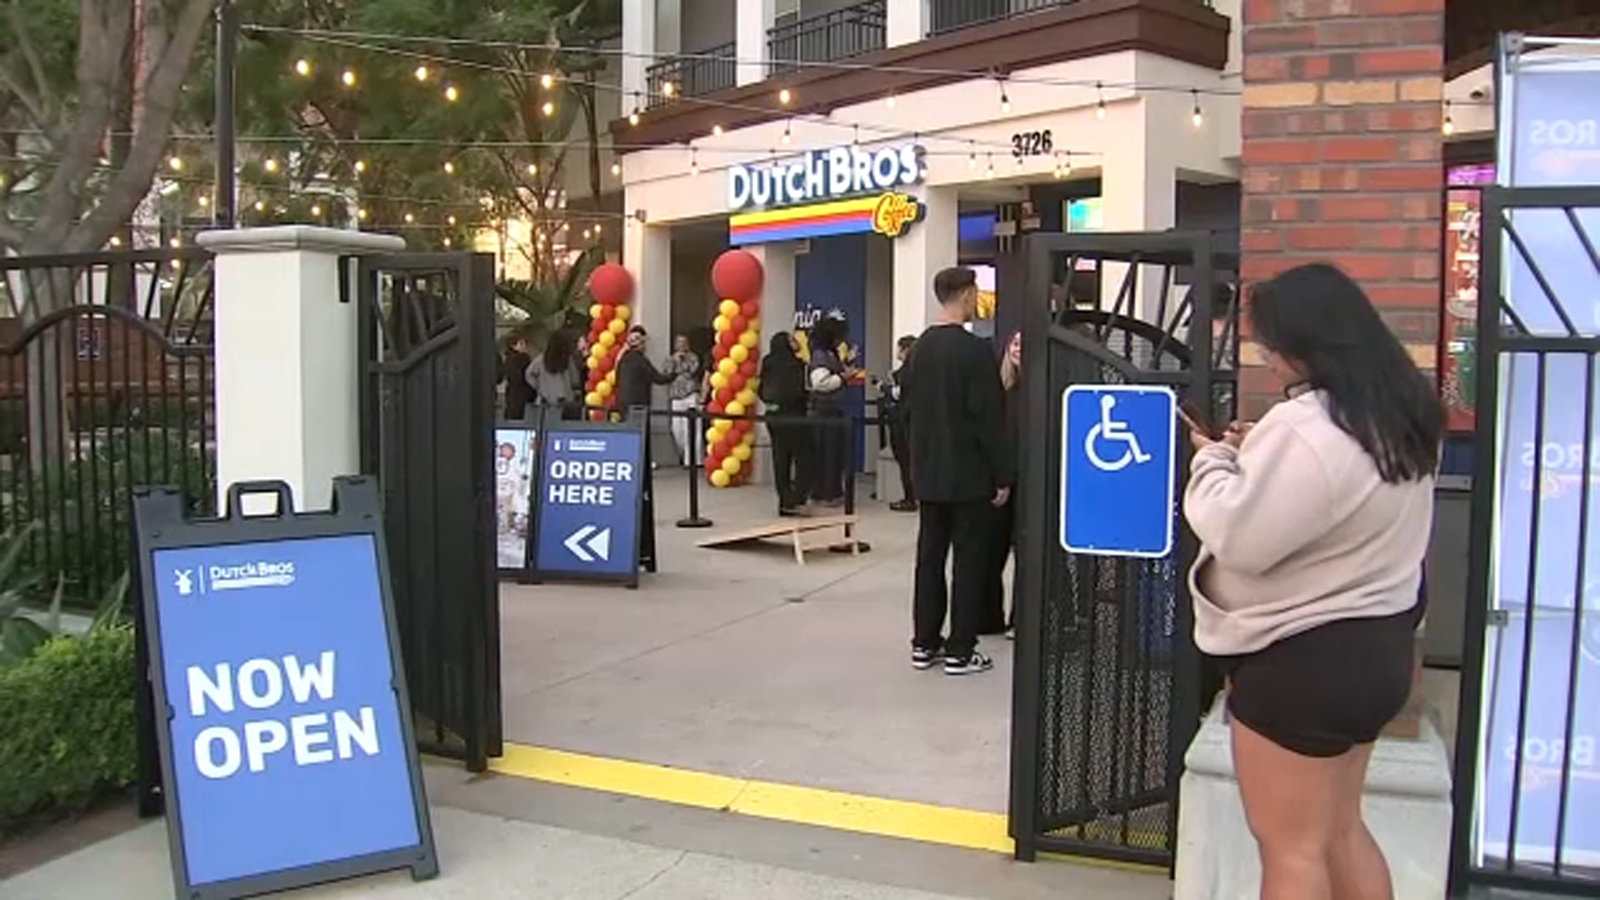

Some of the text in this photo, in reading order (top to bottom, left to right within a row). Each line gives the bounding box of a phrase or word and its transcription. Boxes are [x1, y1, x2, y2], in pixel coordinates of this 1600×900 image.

[1011, 129, 1053, 158] 3726
[728, 150, 825, 208] DUTCH
[550, 460, 633, 481] ORDER
[549, 484, 614, 505] HERE
[187, 650, 336, 717] NOW
[194, 706, 380, 779] OPEN
